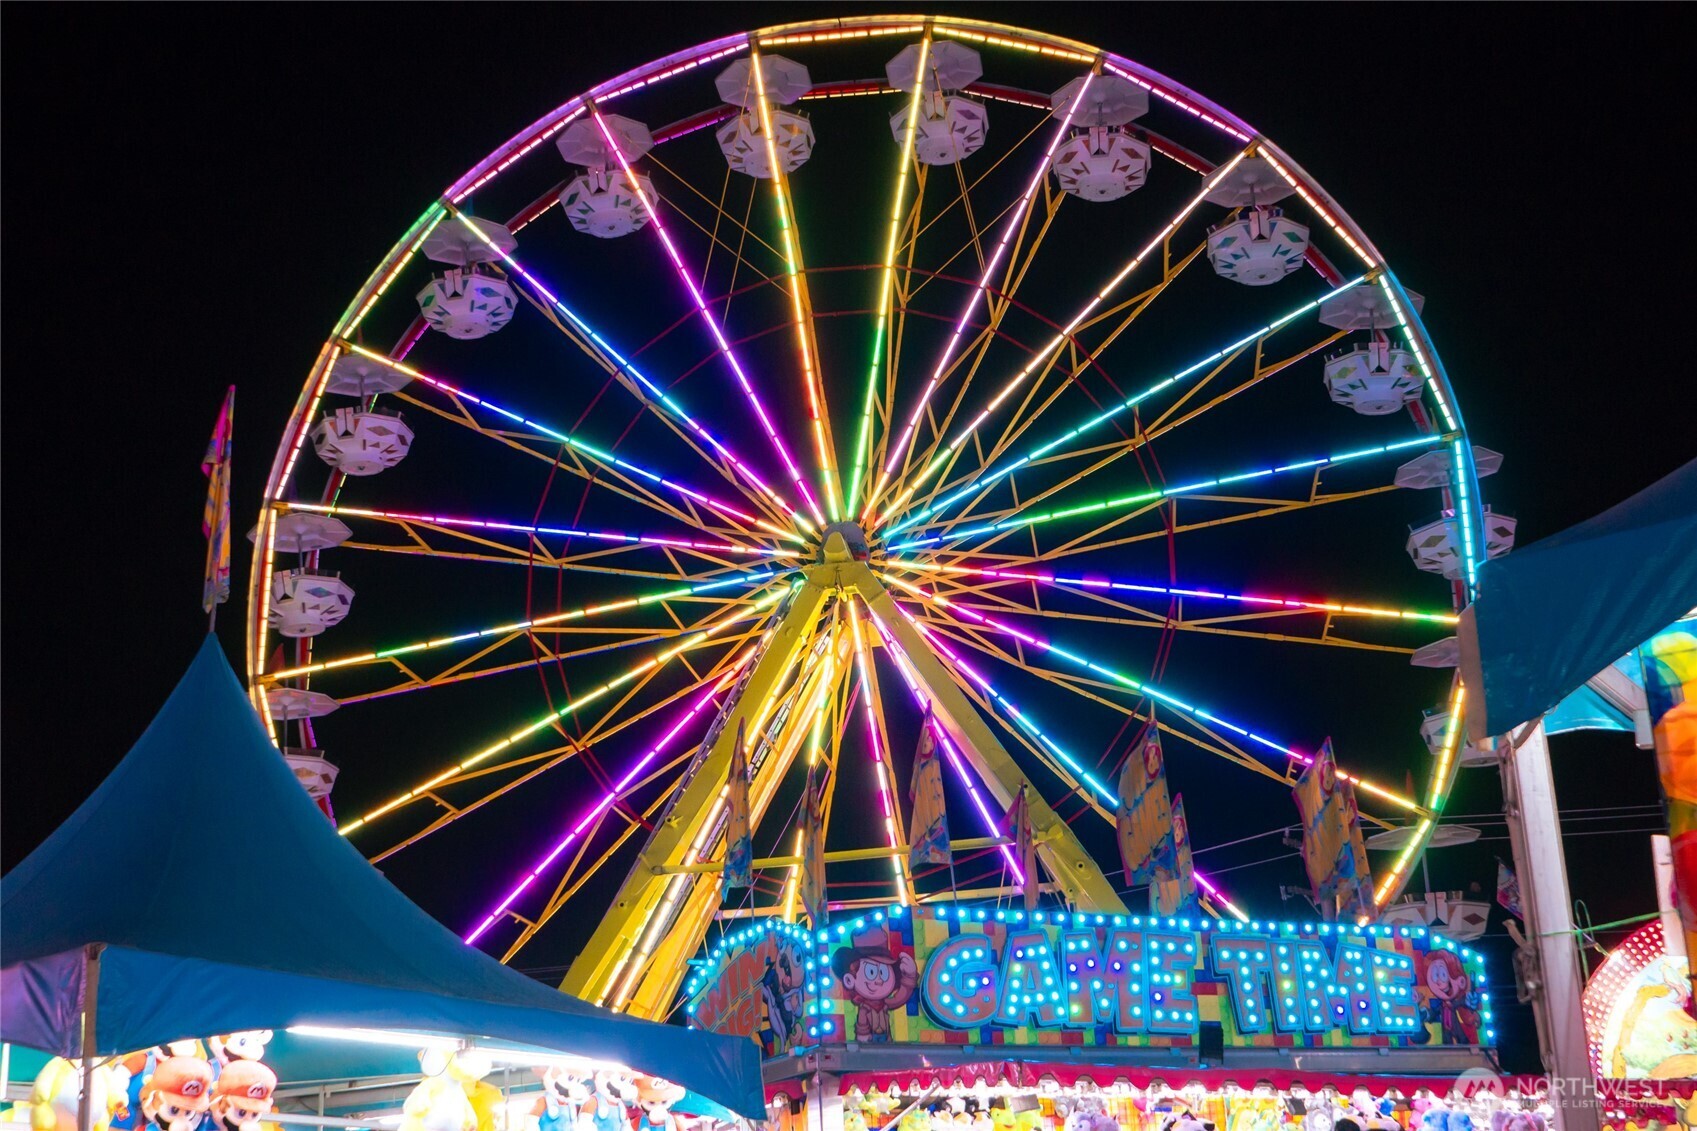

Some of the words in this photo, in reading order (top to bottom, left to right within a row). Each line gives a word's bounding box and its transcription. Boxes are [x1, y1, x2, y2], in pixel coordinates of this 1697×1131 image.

[696, 939, 768, 1029] WIN
[921, 929, 1197, 1033] GAME
[1211, 933, 1420, 1035] TIME
[184, 1083, 200, 1093] M
[249, 1086, 264, 1096] M
